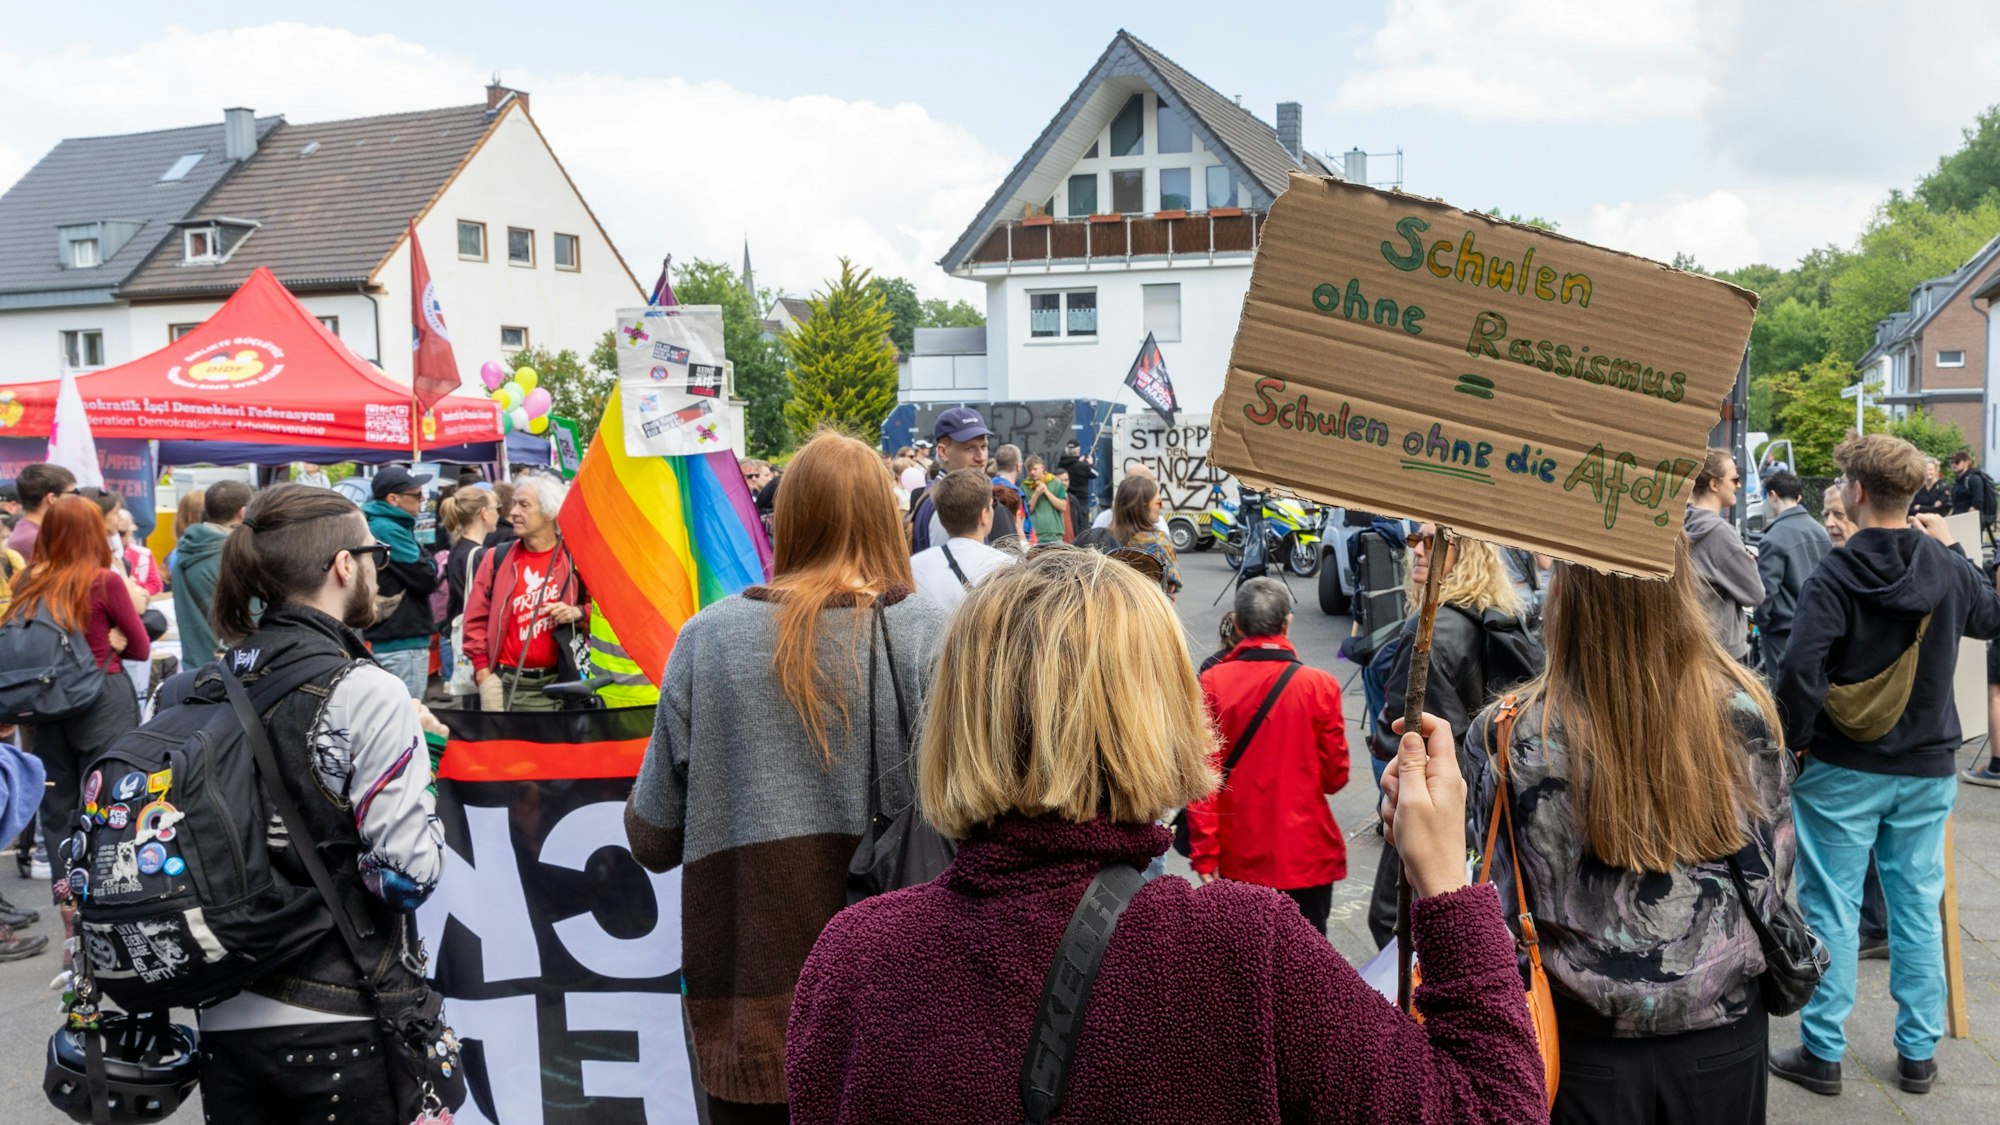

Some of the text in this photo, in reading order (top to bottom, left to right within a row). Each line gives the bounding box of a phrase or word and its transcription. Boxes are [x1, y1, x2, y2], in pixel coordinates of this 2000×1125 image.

[1380, 215, 1593, 309] Schulen
[1312, 277, 1688, 403] ohne Rassismus
[247, 406, 335, 422] Federasyonu
[137, 415, 233, 429] Demokratischer
[235, 420, 326, 435] Arbeitervereine
[1243, 376, 1390, 447] Schulen
[1402, 422, 1493, 471] ohne
[1505, 443, 1558, 484] die
[1166, 447, 1188, 457] DEN
[109, 809, 128, 818] FCK
[140, 966, 175, 983] EMPTY
